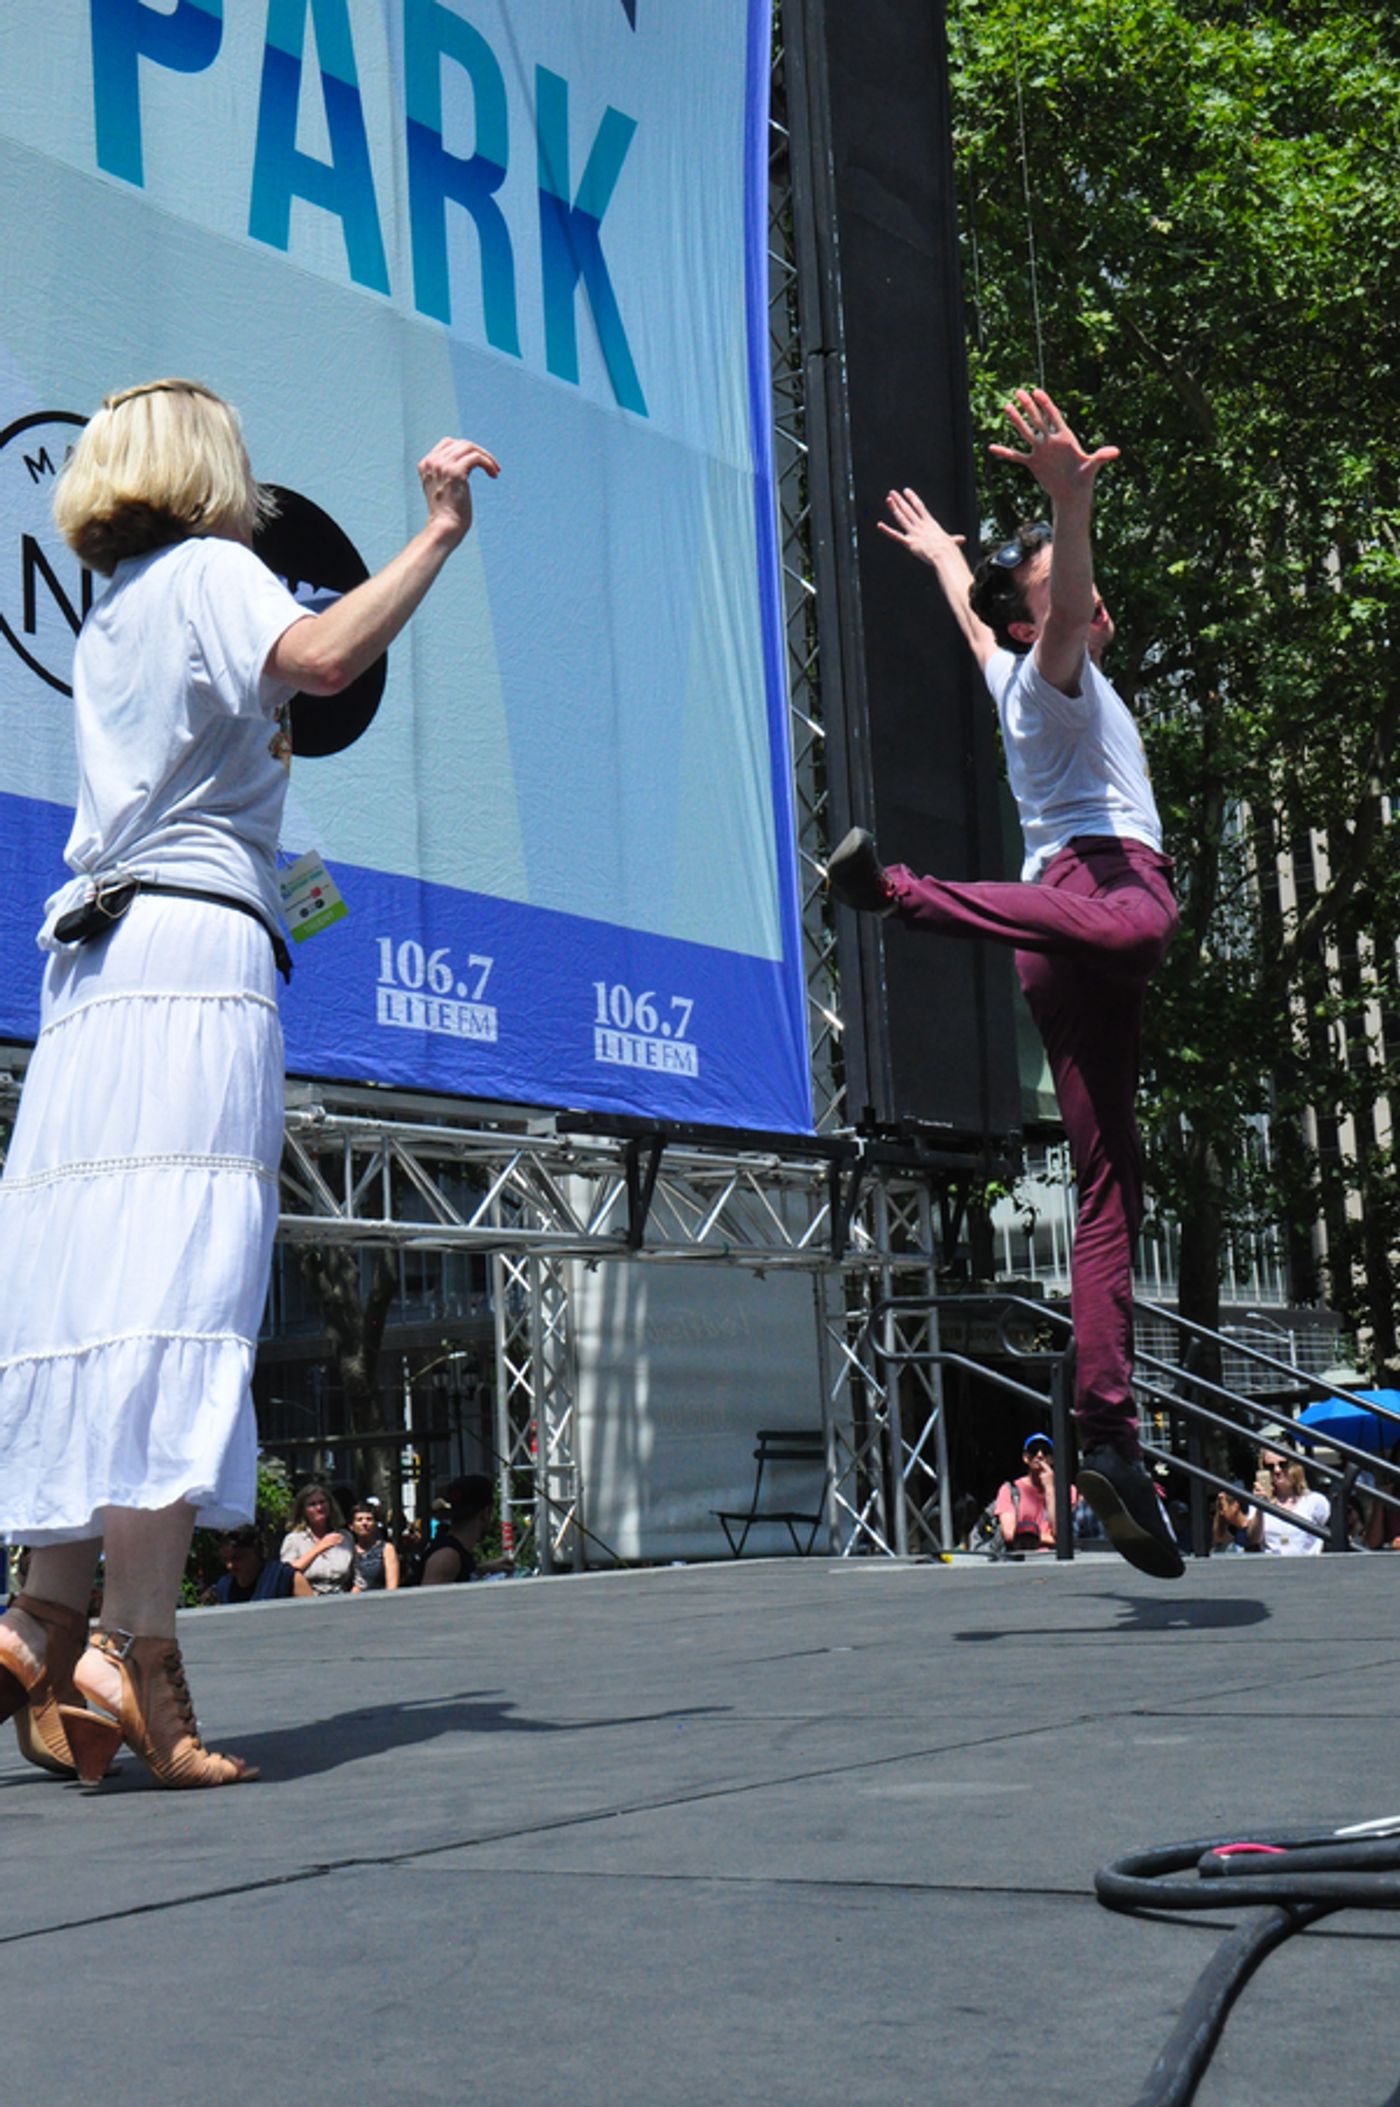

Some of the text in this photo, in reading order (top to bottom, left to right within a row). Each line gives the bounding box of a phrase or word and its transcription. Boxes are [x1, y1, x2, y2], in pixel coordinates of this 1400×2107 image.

[90, 0, 650, 418] PARK
[375, 937, 494, 1000] 106.7
[593, 981, 695, 1039] 106.7
